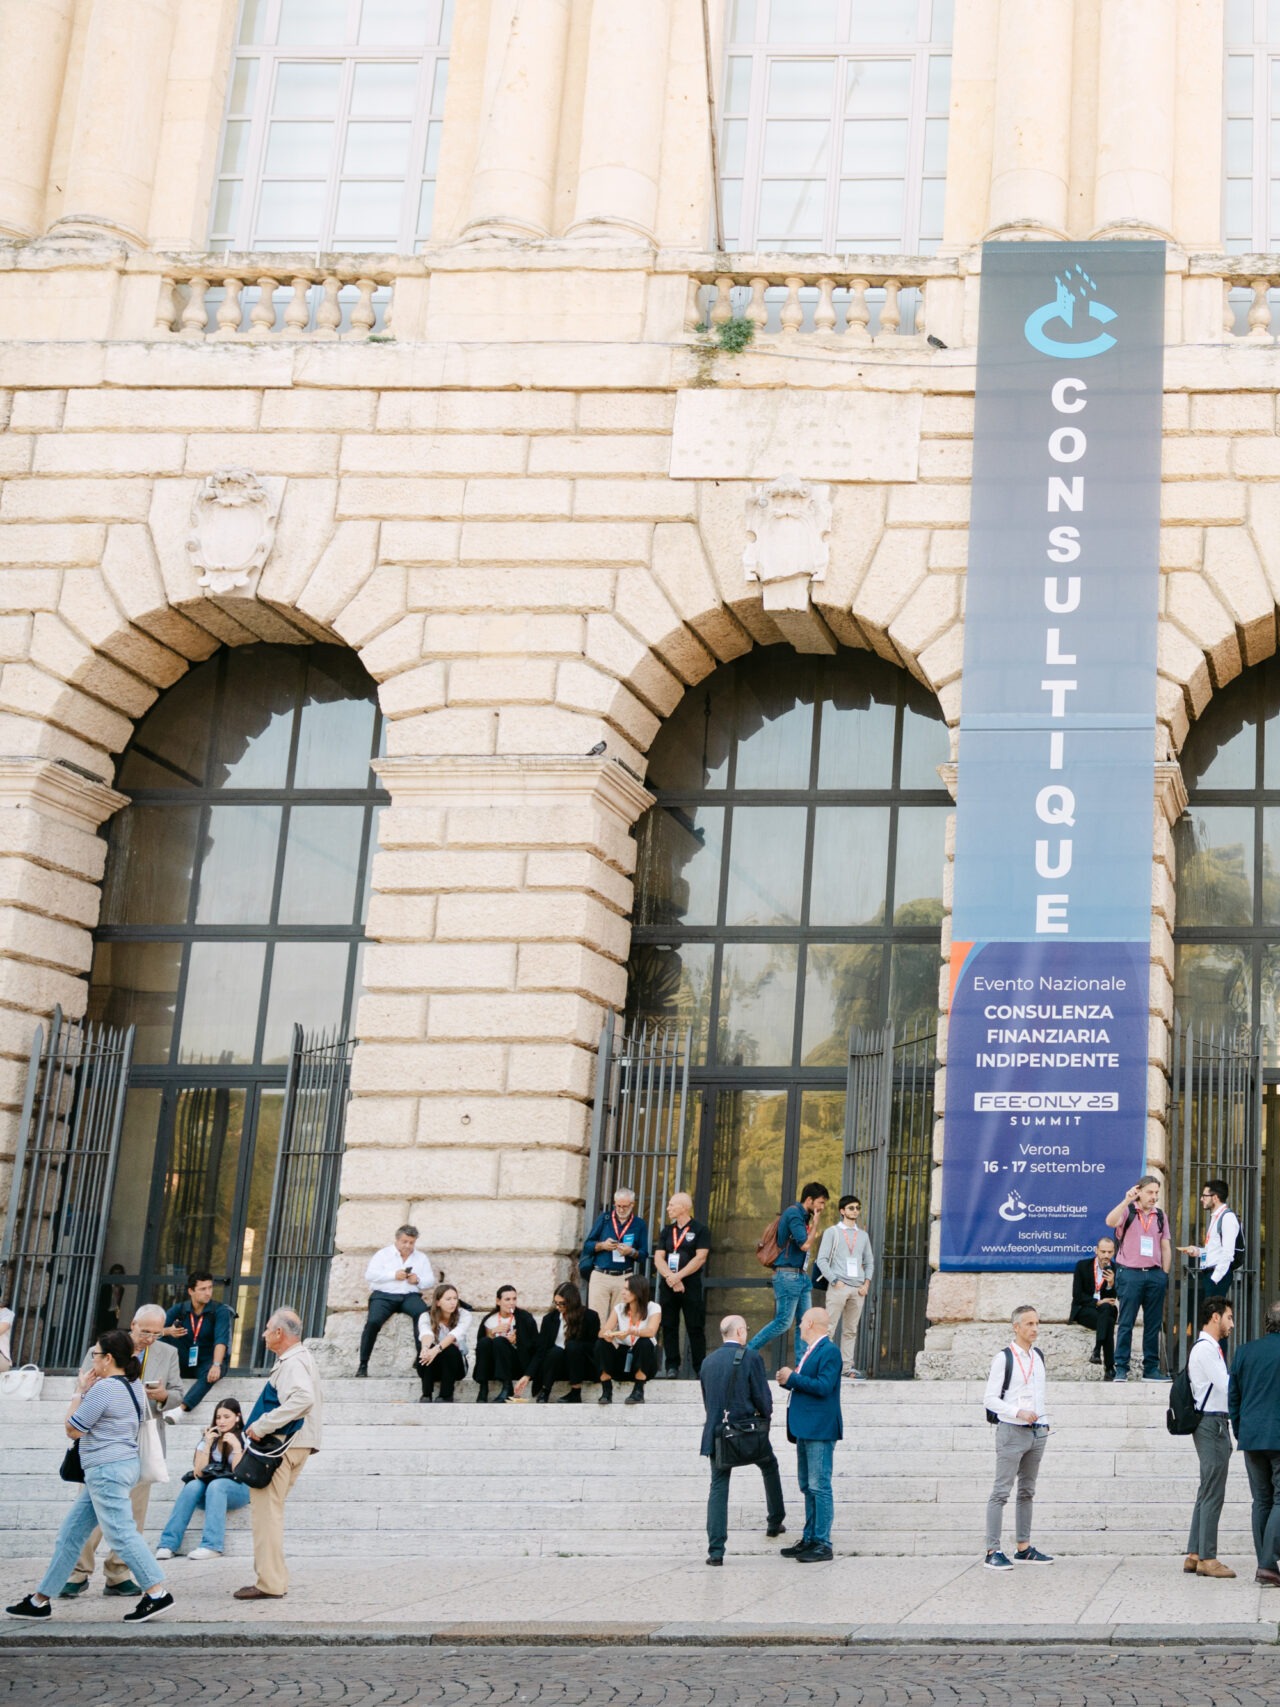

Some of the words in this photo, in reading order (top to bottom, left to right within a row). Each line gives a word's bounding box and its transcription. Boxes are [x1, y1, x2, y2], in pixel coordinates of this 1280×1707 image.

[1035, 377, 1088, 934] CONSULTIQUE
[973, 977, 1034, 991] Evento
[1040, 975, 1127, 991] Nazionale
[984, 1005, 1114, 1020] CONSULENZA
[987, 1029, 1110, 1044] FINANZIARIA
[975, 1053, 1120, 1068] INDIPENDENTE
[979, 1095, 1082, 1109] FEE-ONLY
[1010, 1116, 1082, 1126] SUMMIT
[1019, 1143, 1070, 1156] Verona
[983, 1161, 999, 1173] 16
[1012, 1161, 1027, 1173] 17
[1030, 1160, 1106, 1174] settembre
[1027, 1203, 1088, 1214] Consultique
[1018, 1231, 1051, 1240] Iscriviti
[1053, 1232, 1067, 1240] su:
